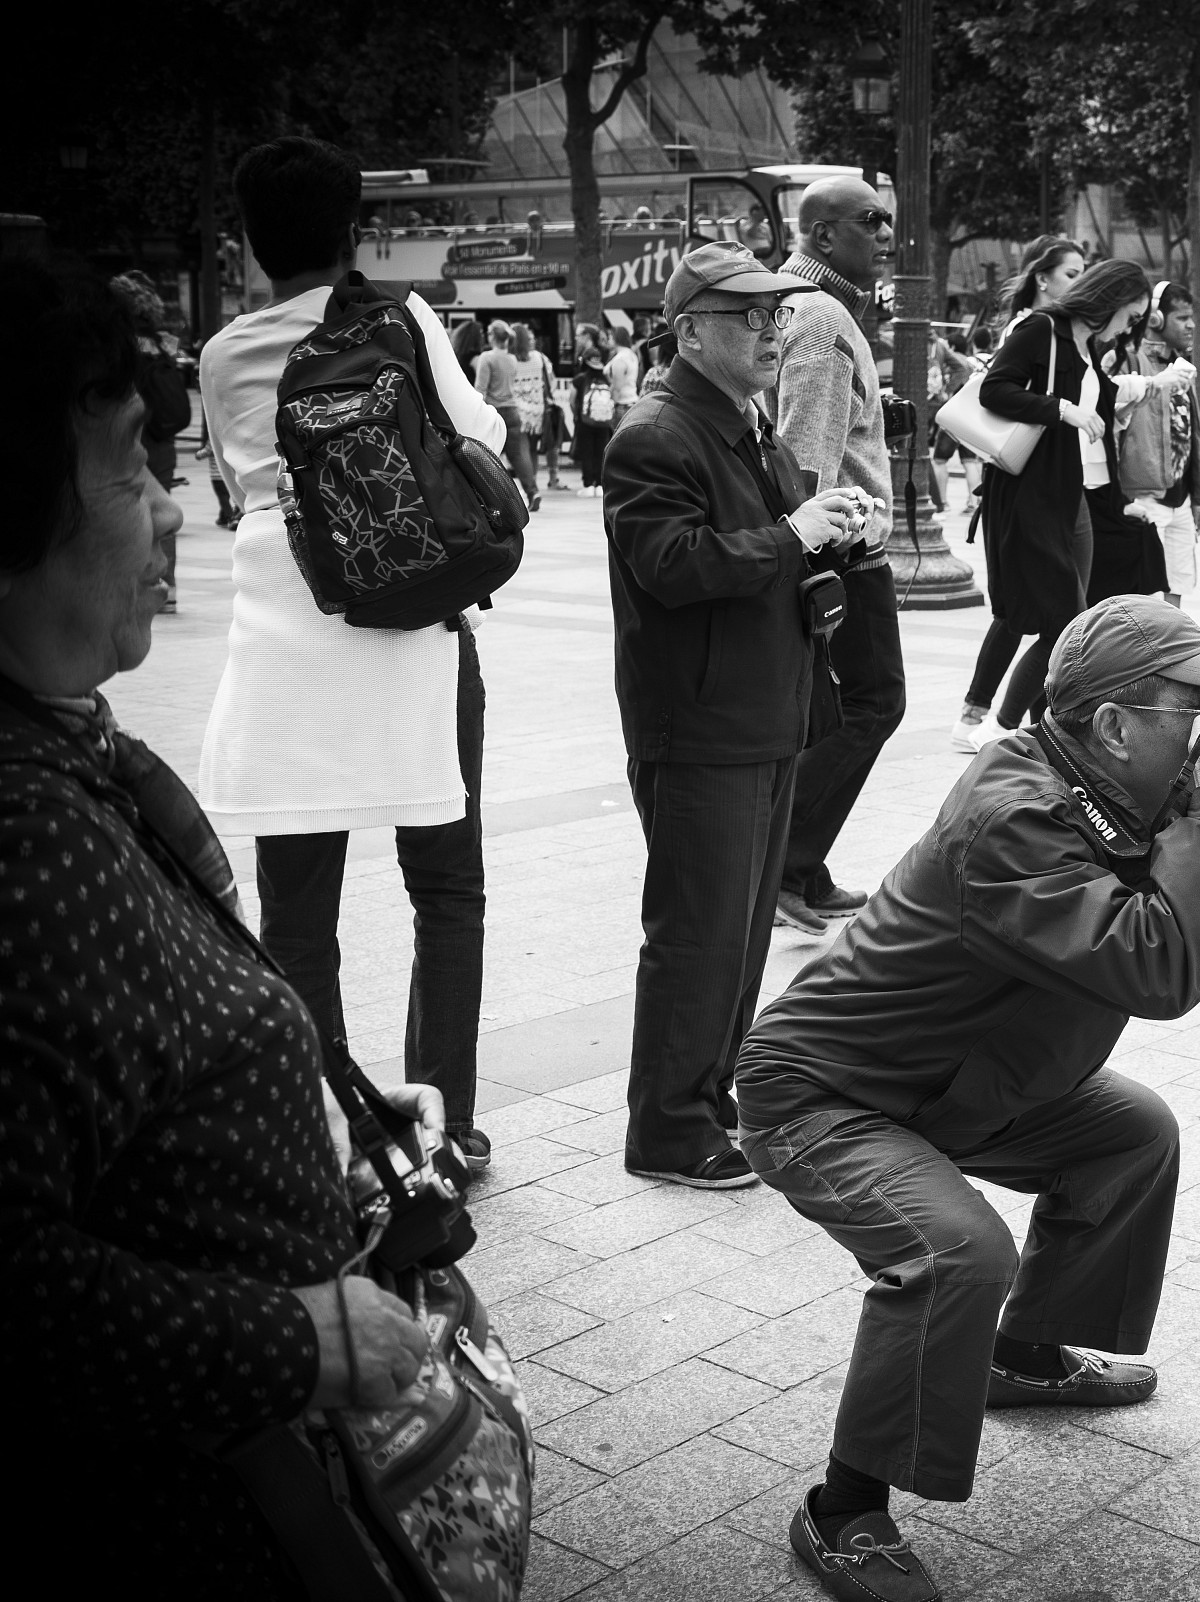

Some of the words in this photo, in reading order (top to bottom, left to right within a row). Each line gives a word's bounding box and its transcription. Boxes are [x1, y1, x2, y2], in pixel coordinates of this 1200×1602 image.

[471, 244, 518, 256] Monuments
[510, 262, 529, 274] Paris
[601, 240, 692, 299] oxity
[824, 604, 843, 618] Canon
[1071, 786, 1118, 841] Canon
